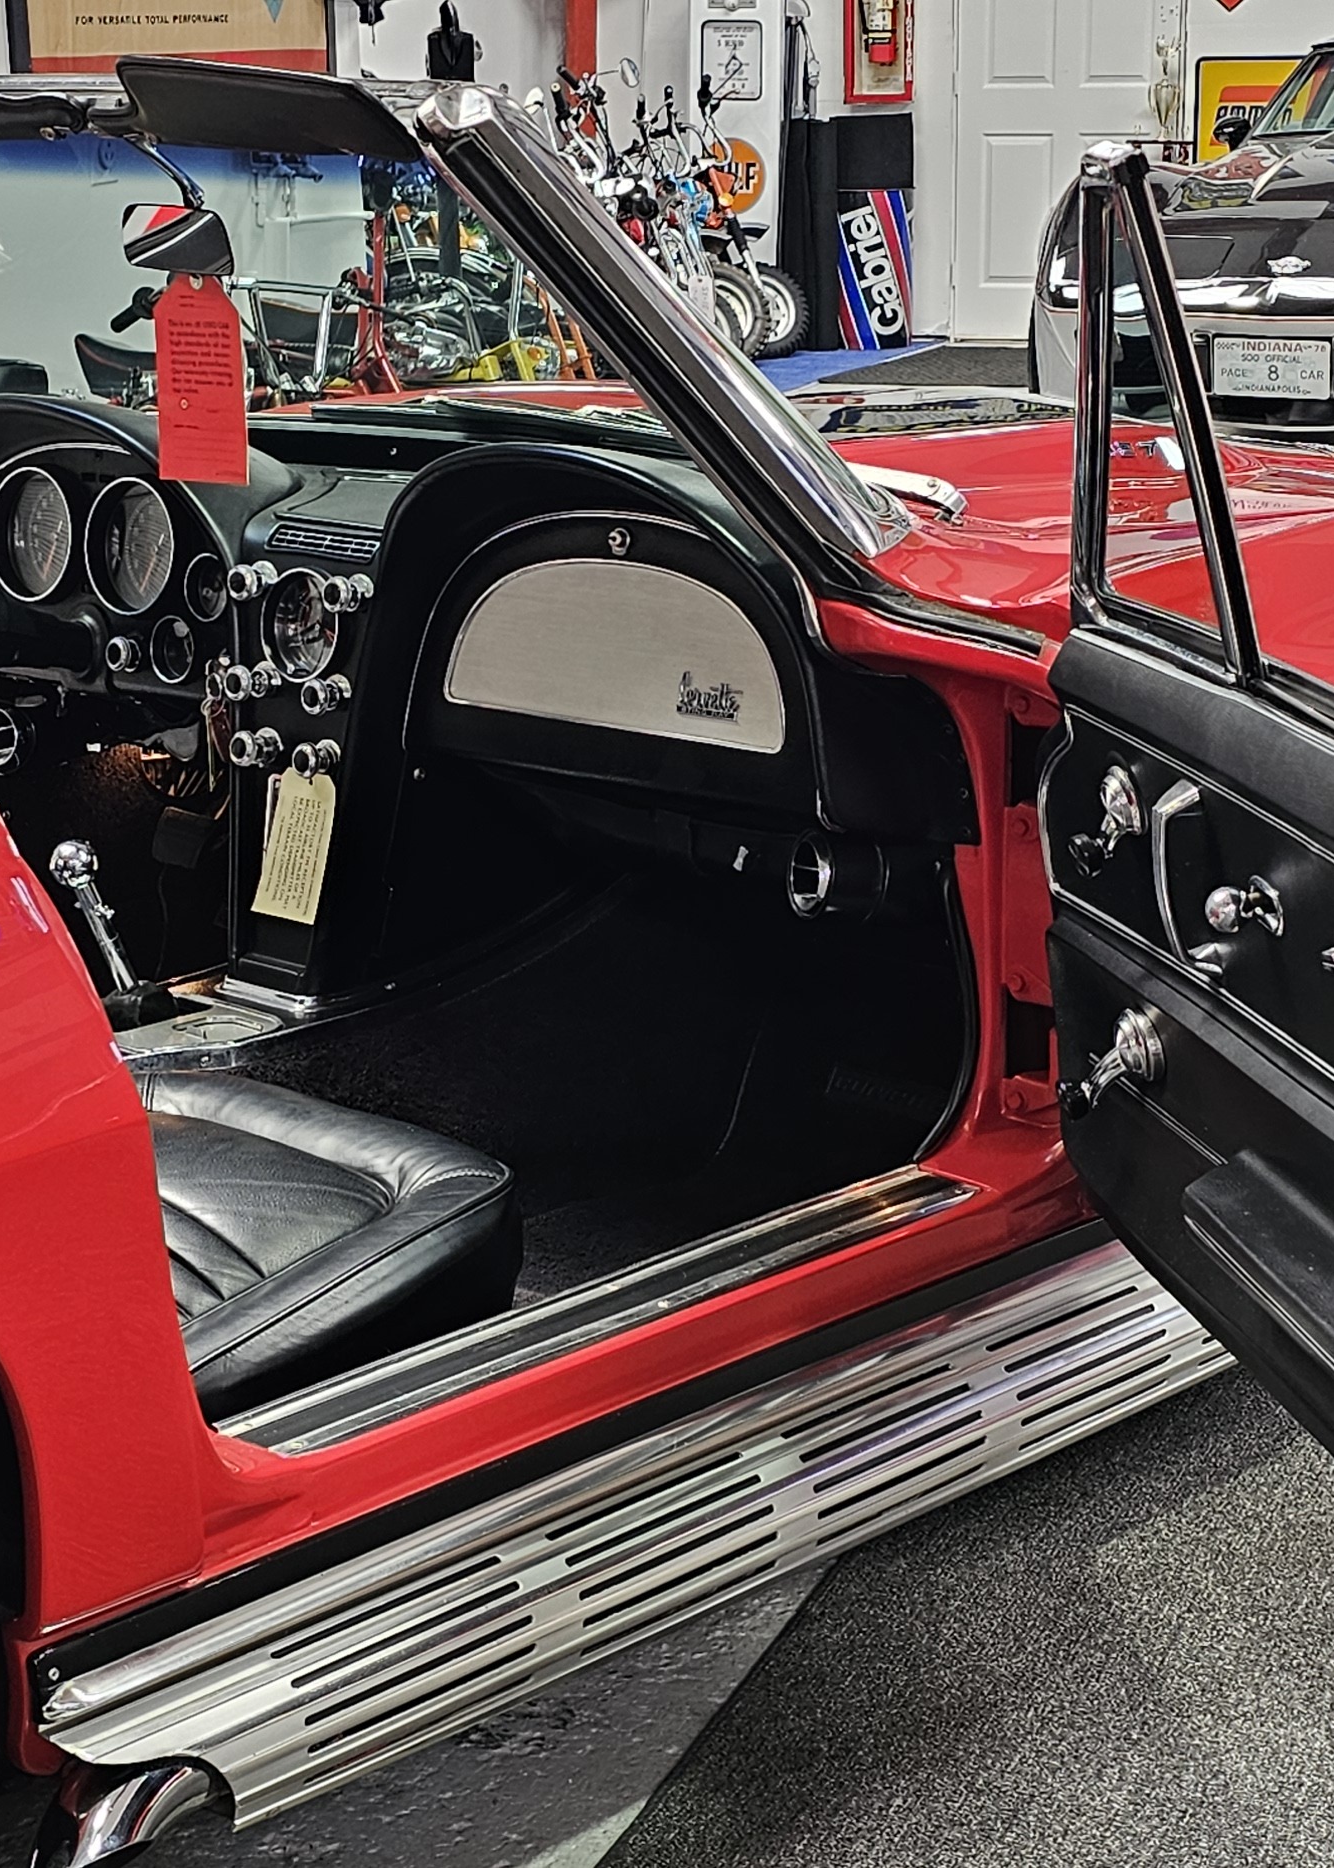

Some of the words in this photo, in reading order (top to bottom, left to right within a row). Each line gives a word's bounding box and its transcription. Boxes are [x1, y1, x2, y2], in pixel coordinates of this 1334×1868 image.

[75, 15, 94, 25] FOR
[98, 15, 142, 25] VERSATILE
[145, 15, 169, 25] TOTAL
[172, 14, 229, 24] PERFORMANCE
[840, 205, 905, 336] Gabriel
[1241, 341, 1304, 353] INDIANA
[1241, 353, 1260, 362] 500
[1264, 354, 1302, 364] OFFICIAL
[1221, 368, 1247, 378] PACE
[1267, 364, 1280, 381] 8
[1299, 369, 1325, 380] CAR
[1241, 384, 1302, 394] INDIANAPOLIS
